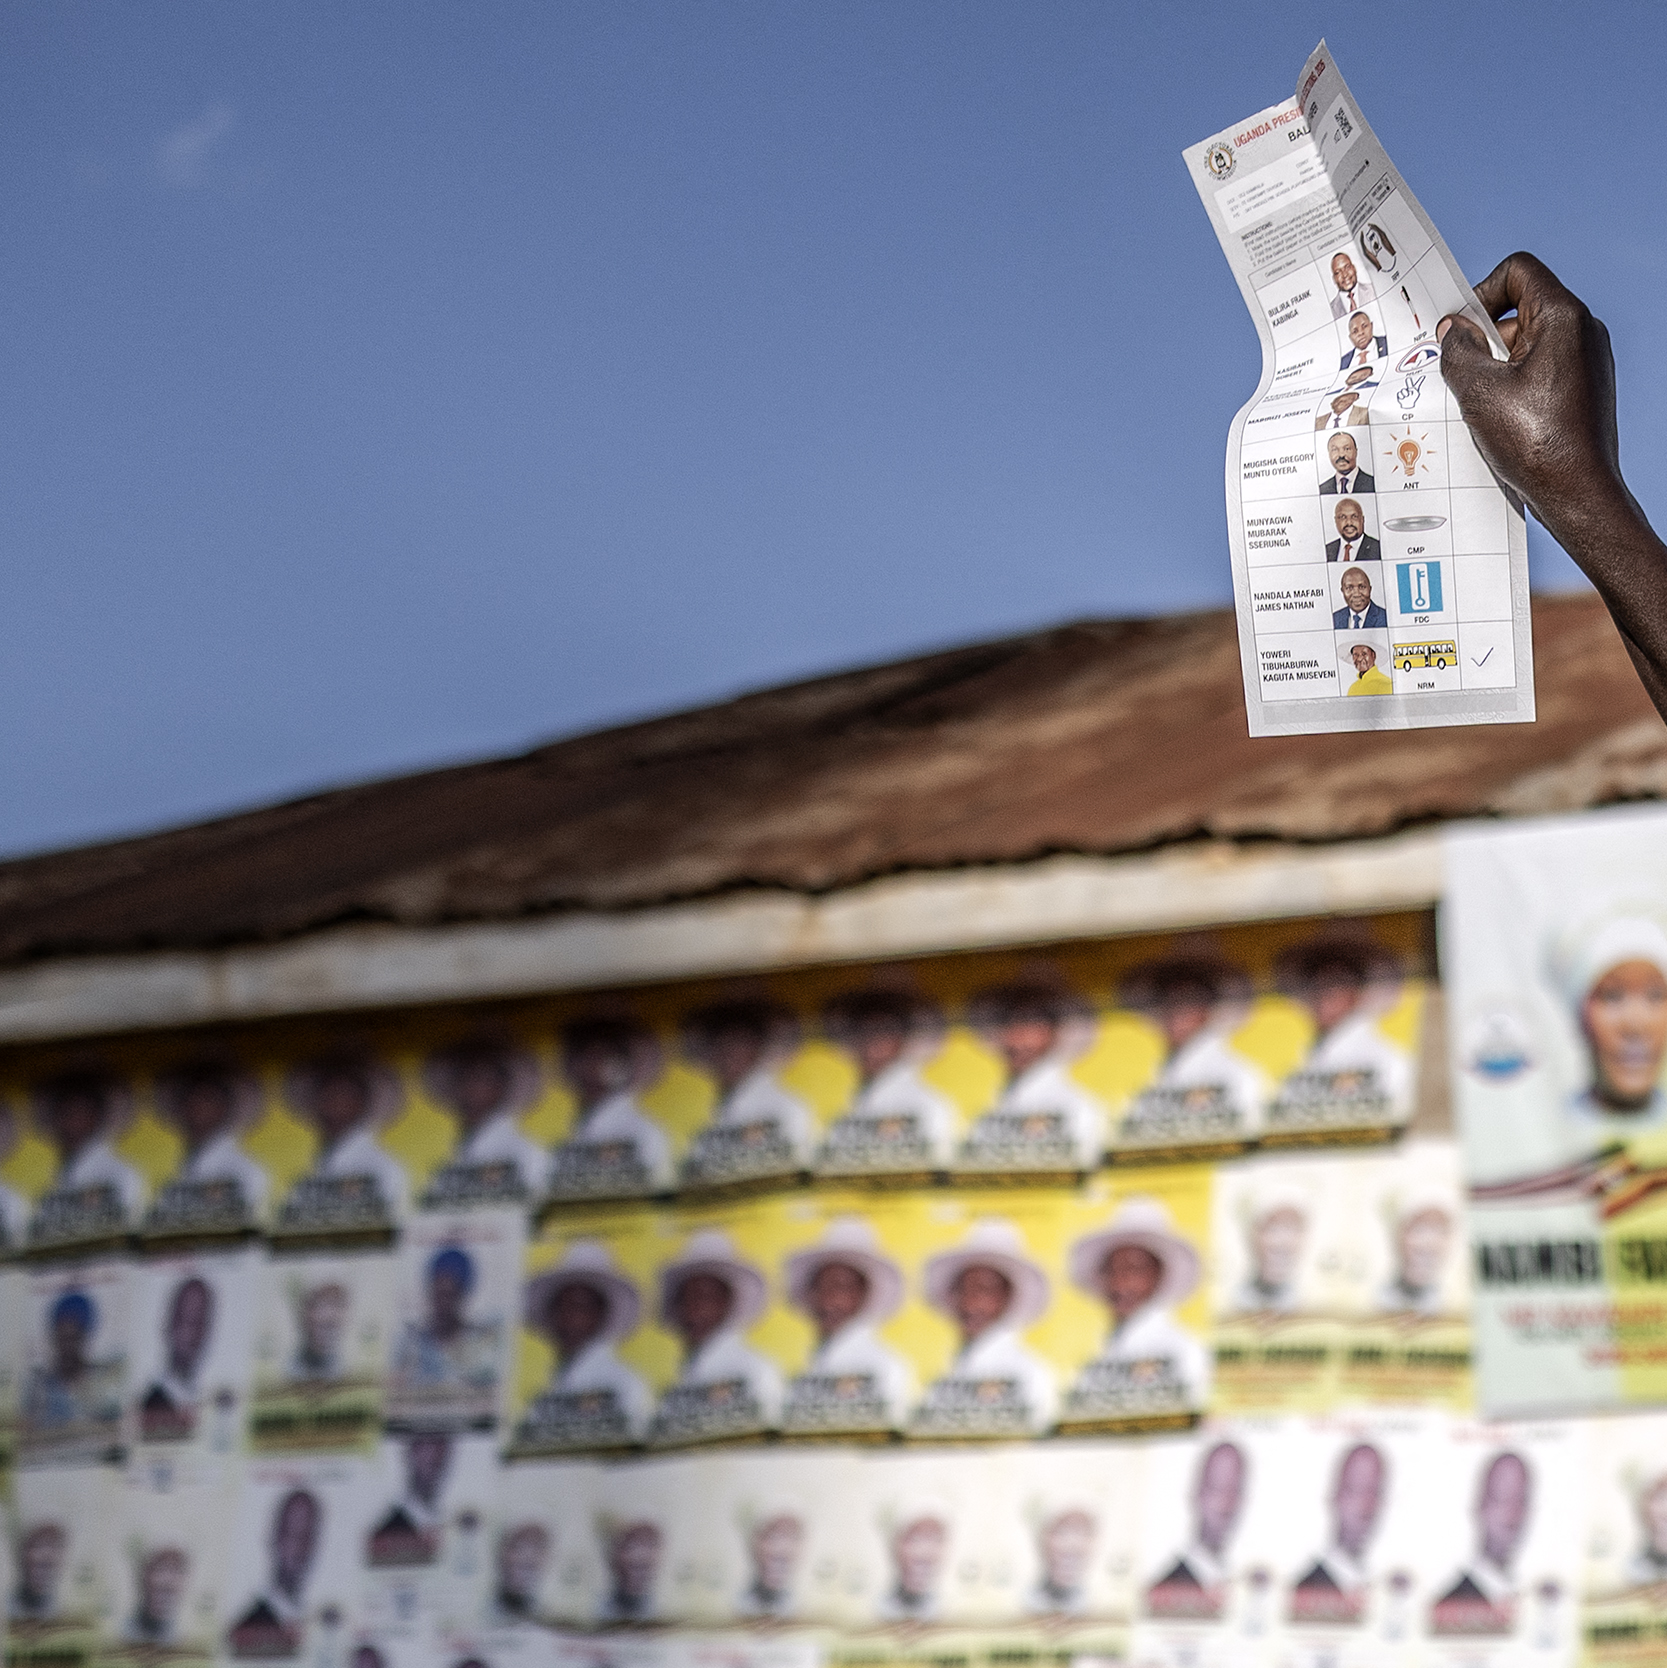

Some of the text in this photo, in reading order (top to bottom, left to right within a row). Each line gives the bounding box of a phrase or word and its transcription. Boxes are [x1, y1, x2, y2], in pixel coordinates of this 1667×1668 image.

[1233, 122, 1271, 147] UGANDA
[1282, 408, 1311, 419] JOSEPH
[1402, 413, 1414, 421] CP
[1243, 453, 1315, 470] MUGISHA GREGORY
[1243, 465, 1298, 480] MUNTU OYERA
[1403, 481, 1420, 490] ANT
[1246, 515, 1293, 527] MUNYAGWA
[1248, 528, 1287, 538] MUBARAK
[1248, 538, 1291, 549] SSERUNGA
[1407, 546, 1425, 555] CMP
[1254, 588, 1324, 601] NANDALA MAFABI
[1255, 600, 1315, 613] JAMES NATHAN
[1414, 615, 1430, 624] FDC
[1260, 649, 1291, 660] YOWERI
[1261, 659, 1319, 672] TIBUHABURWA
[1263, 669, 1336, 683] KAGUTA MUSEVENI
[1417, 682, 1435, 690] NRM
